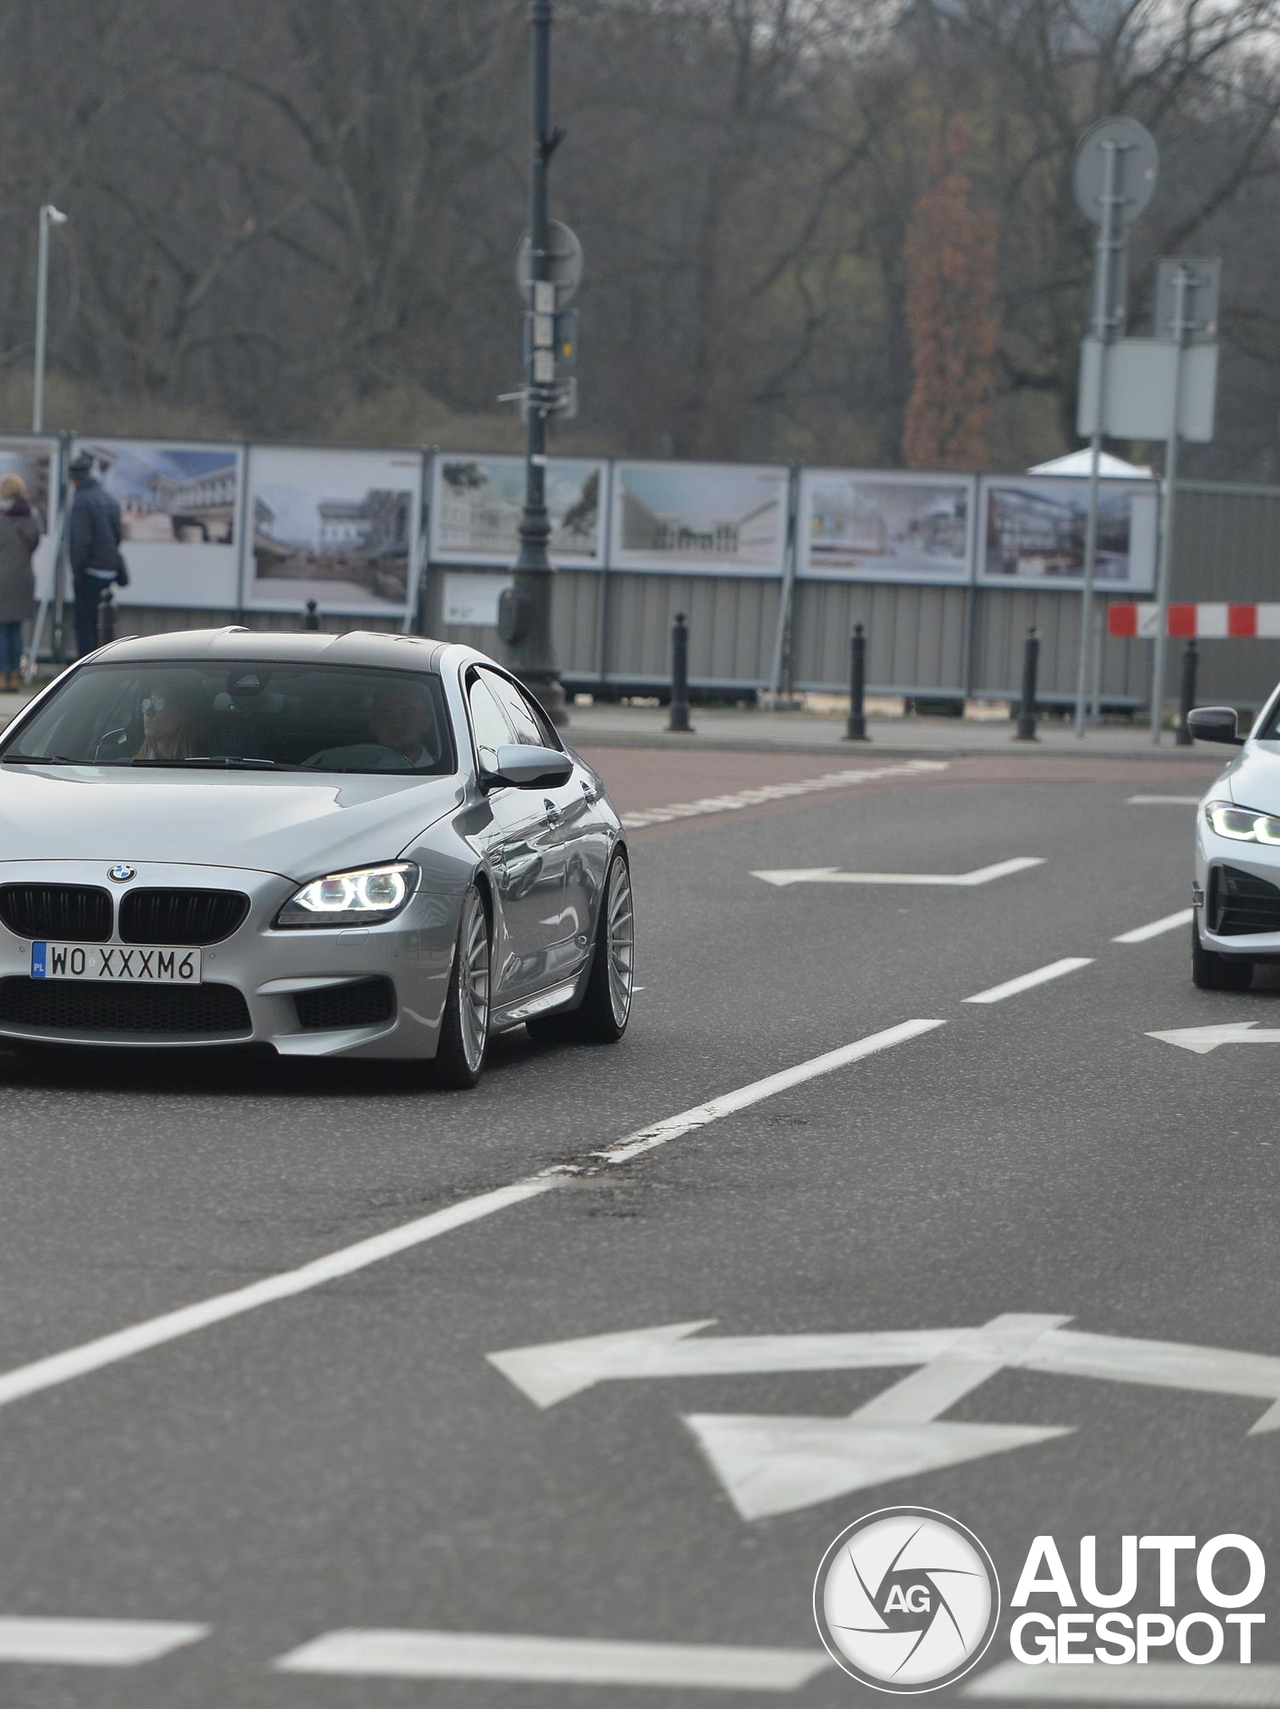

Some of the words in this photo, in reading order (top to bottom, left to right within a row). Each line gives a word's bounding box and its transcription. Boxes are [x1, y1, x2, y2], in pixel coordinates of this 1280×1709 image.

[34, 964, 44, 972] PL
[52, 947, 86, 975] WO
[99, 948, 194, 979] XXXM6
